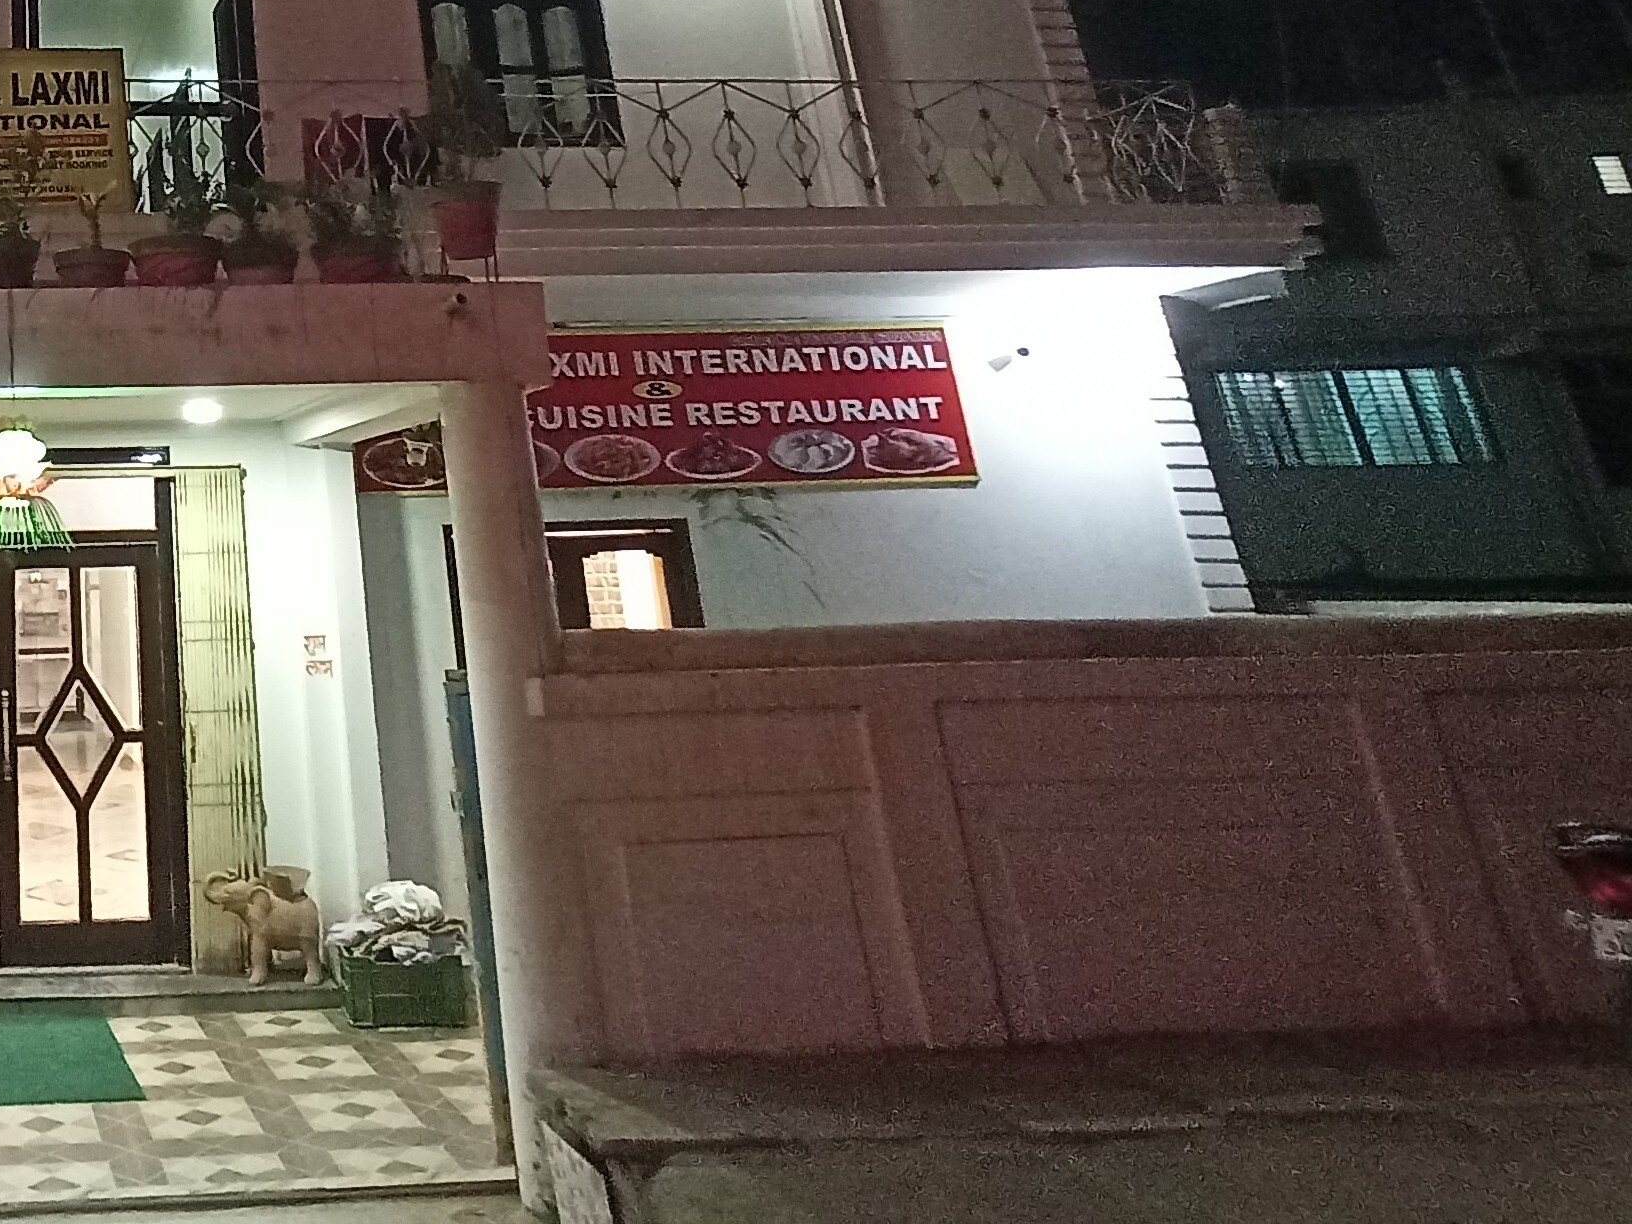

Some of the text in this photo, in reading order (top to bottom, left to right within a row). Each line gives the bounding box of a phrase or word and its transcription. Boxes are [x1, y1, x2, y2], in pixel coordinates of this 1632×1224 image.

[11, 69, 111, 108] LAXMI
[548, 344, 948, 378] XMI INTERNATIONAL
[645, 382, 672, 397] &
[684, 396, 944, 427] RESTAURANT
